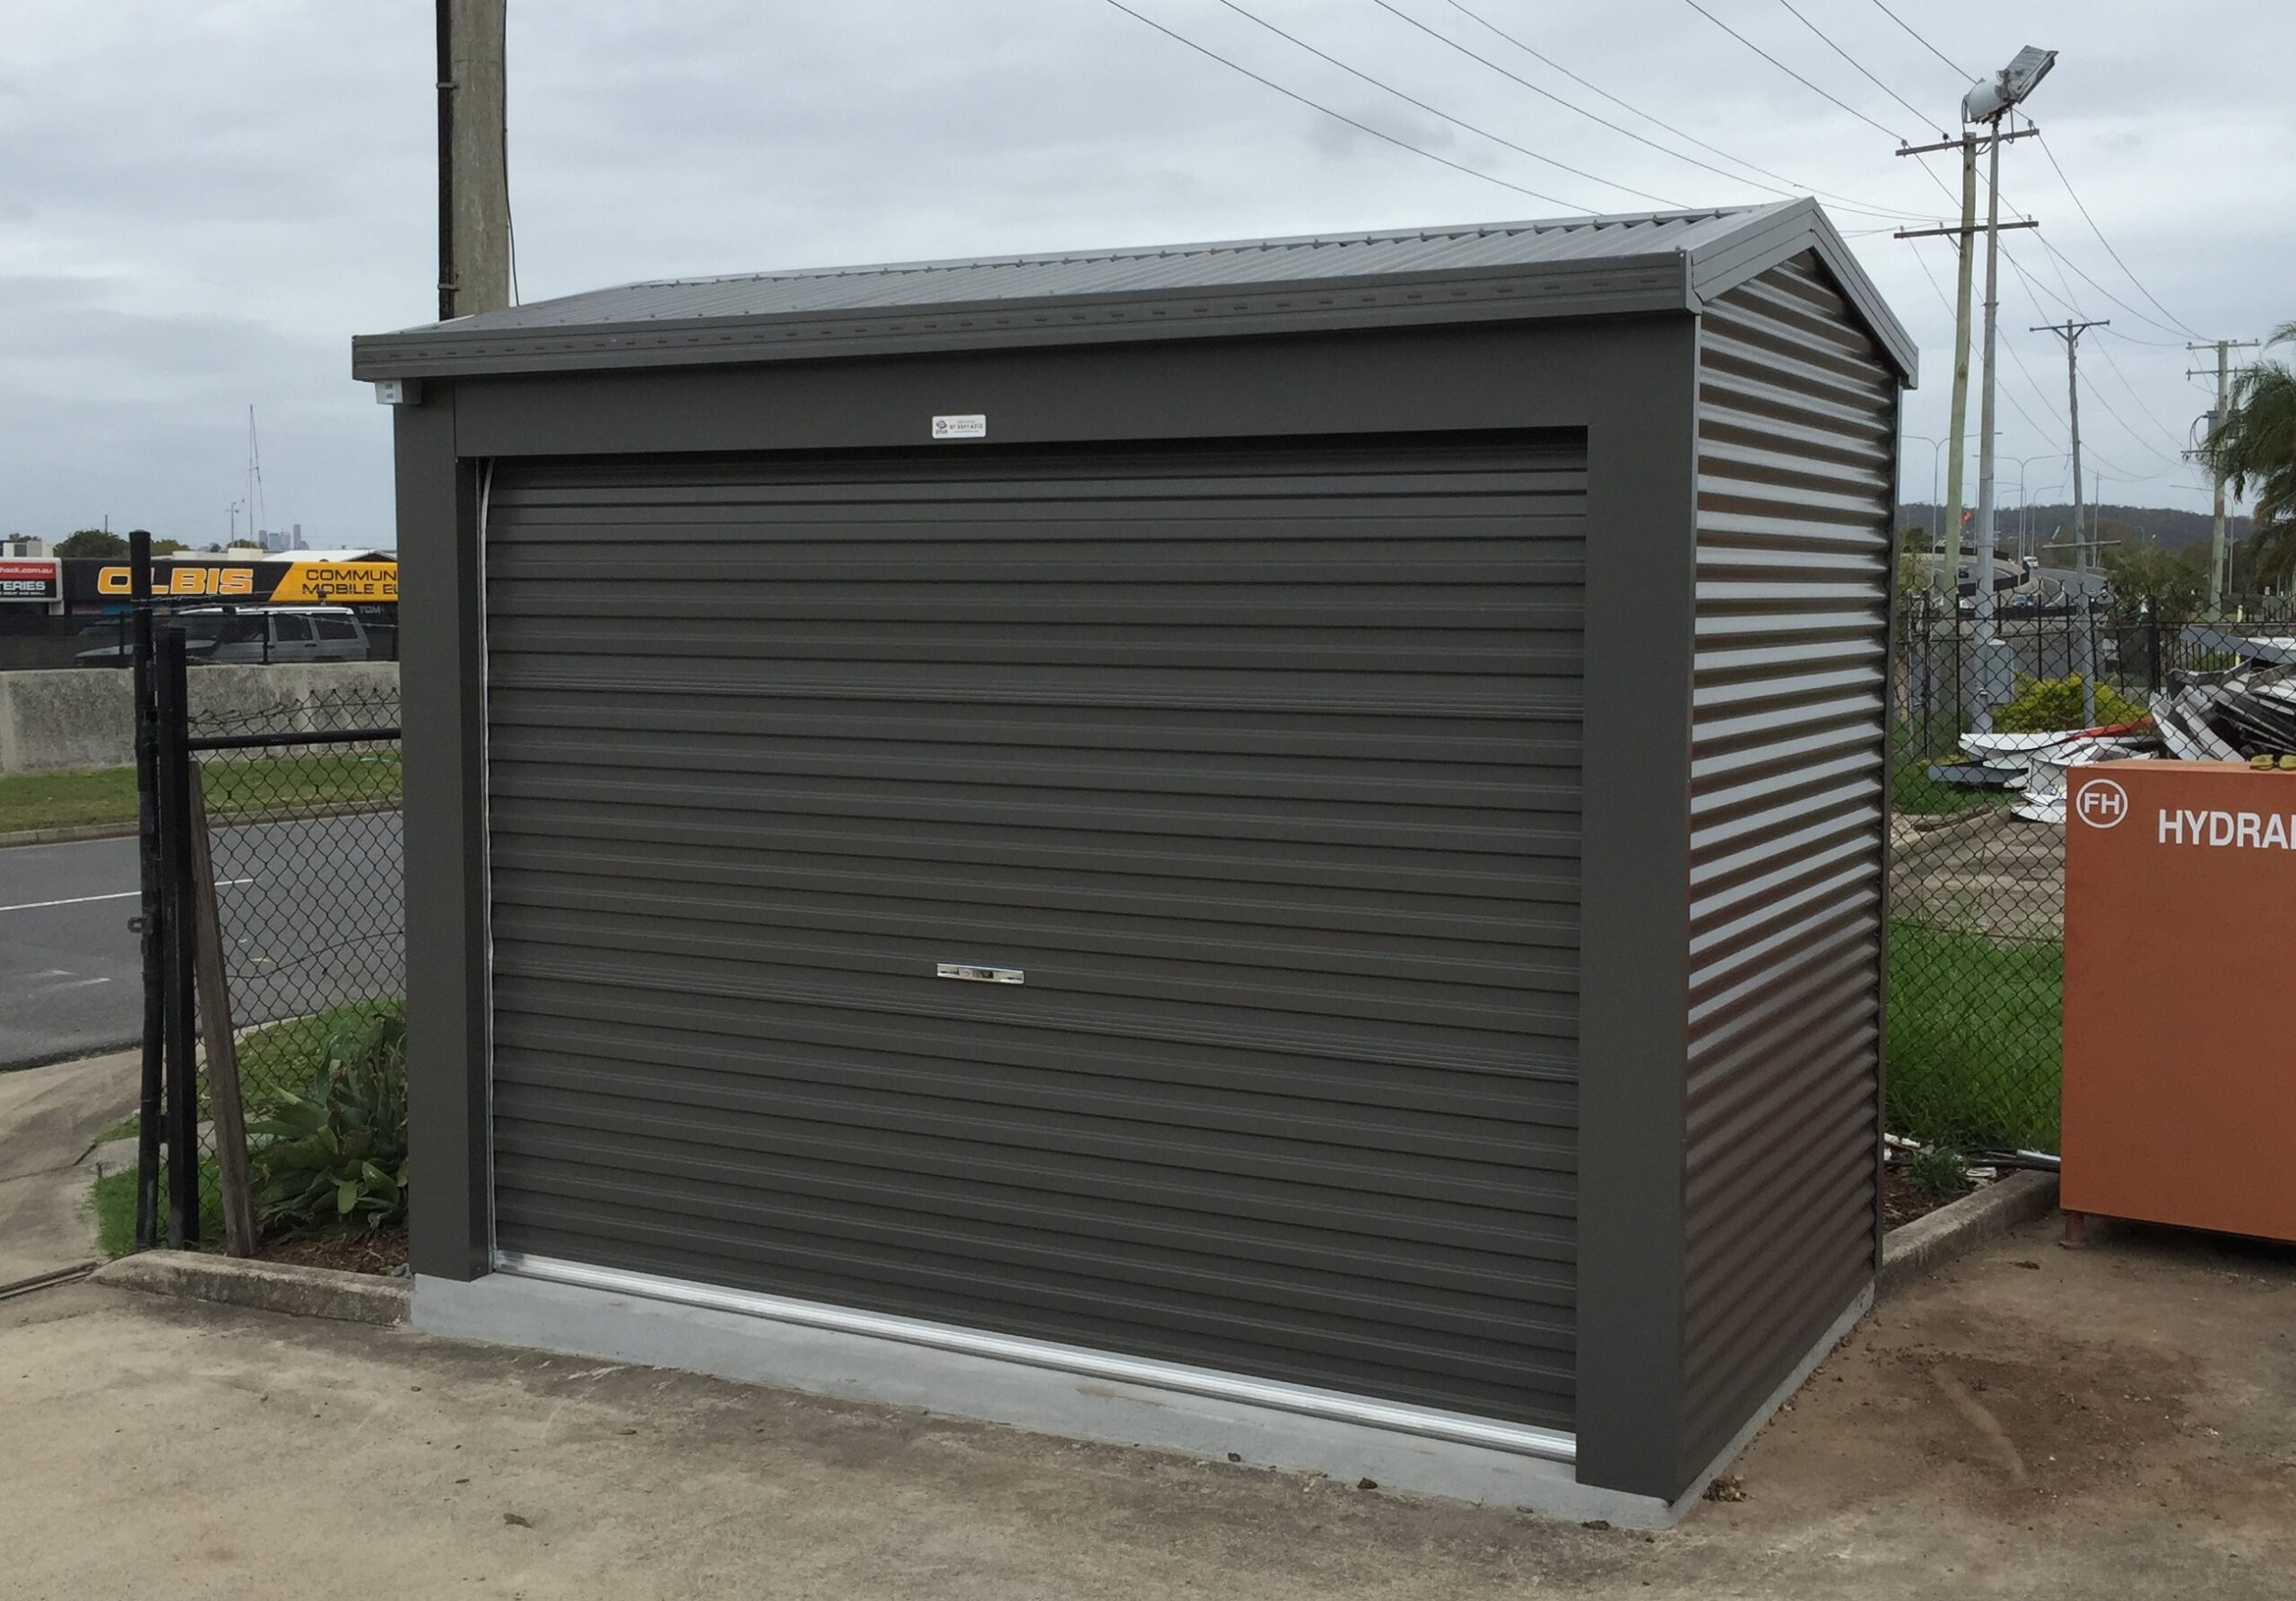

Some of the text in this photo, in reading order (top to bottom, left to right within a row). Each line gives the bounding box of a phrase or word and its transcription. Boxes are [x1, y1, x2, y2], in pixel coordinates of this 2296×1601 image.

[306, 569, 396, 581] COMMUN
[302, 583, 375, 595] MOBILE
[2083, 792, 2121, 815] FH
[2158, 808, 2296, 851] HYDRA
